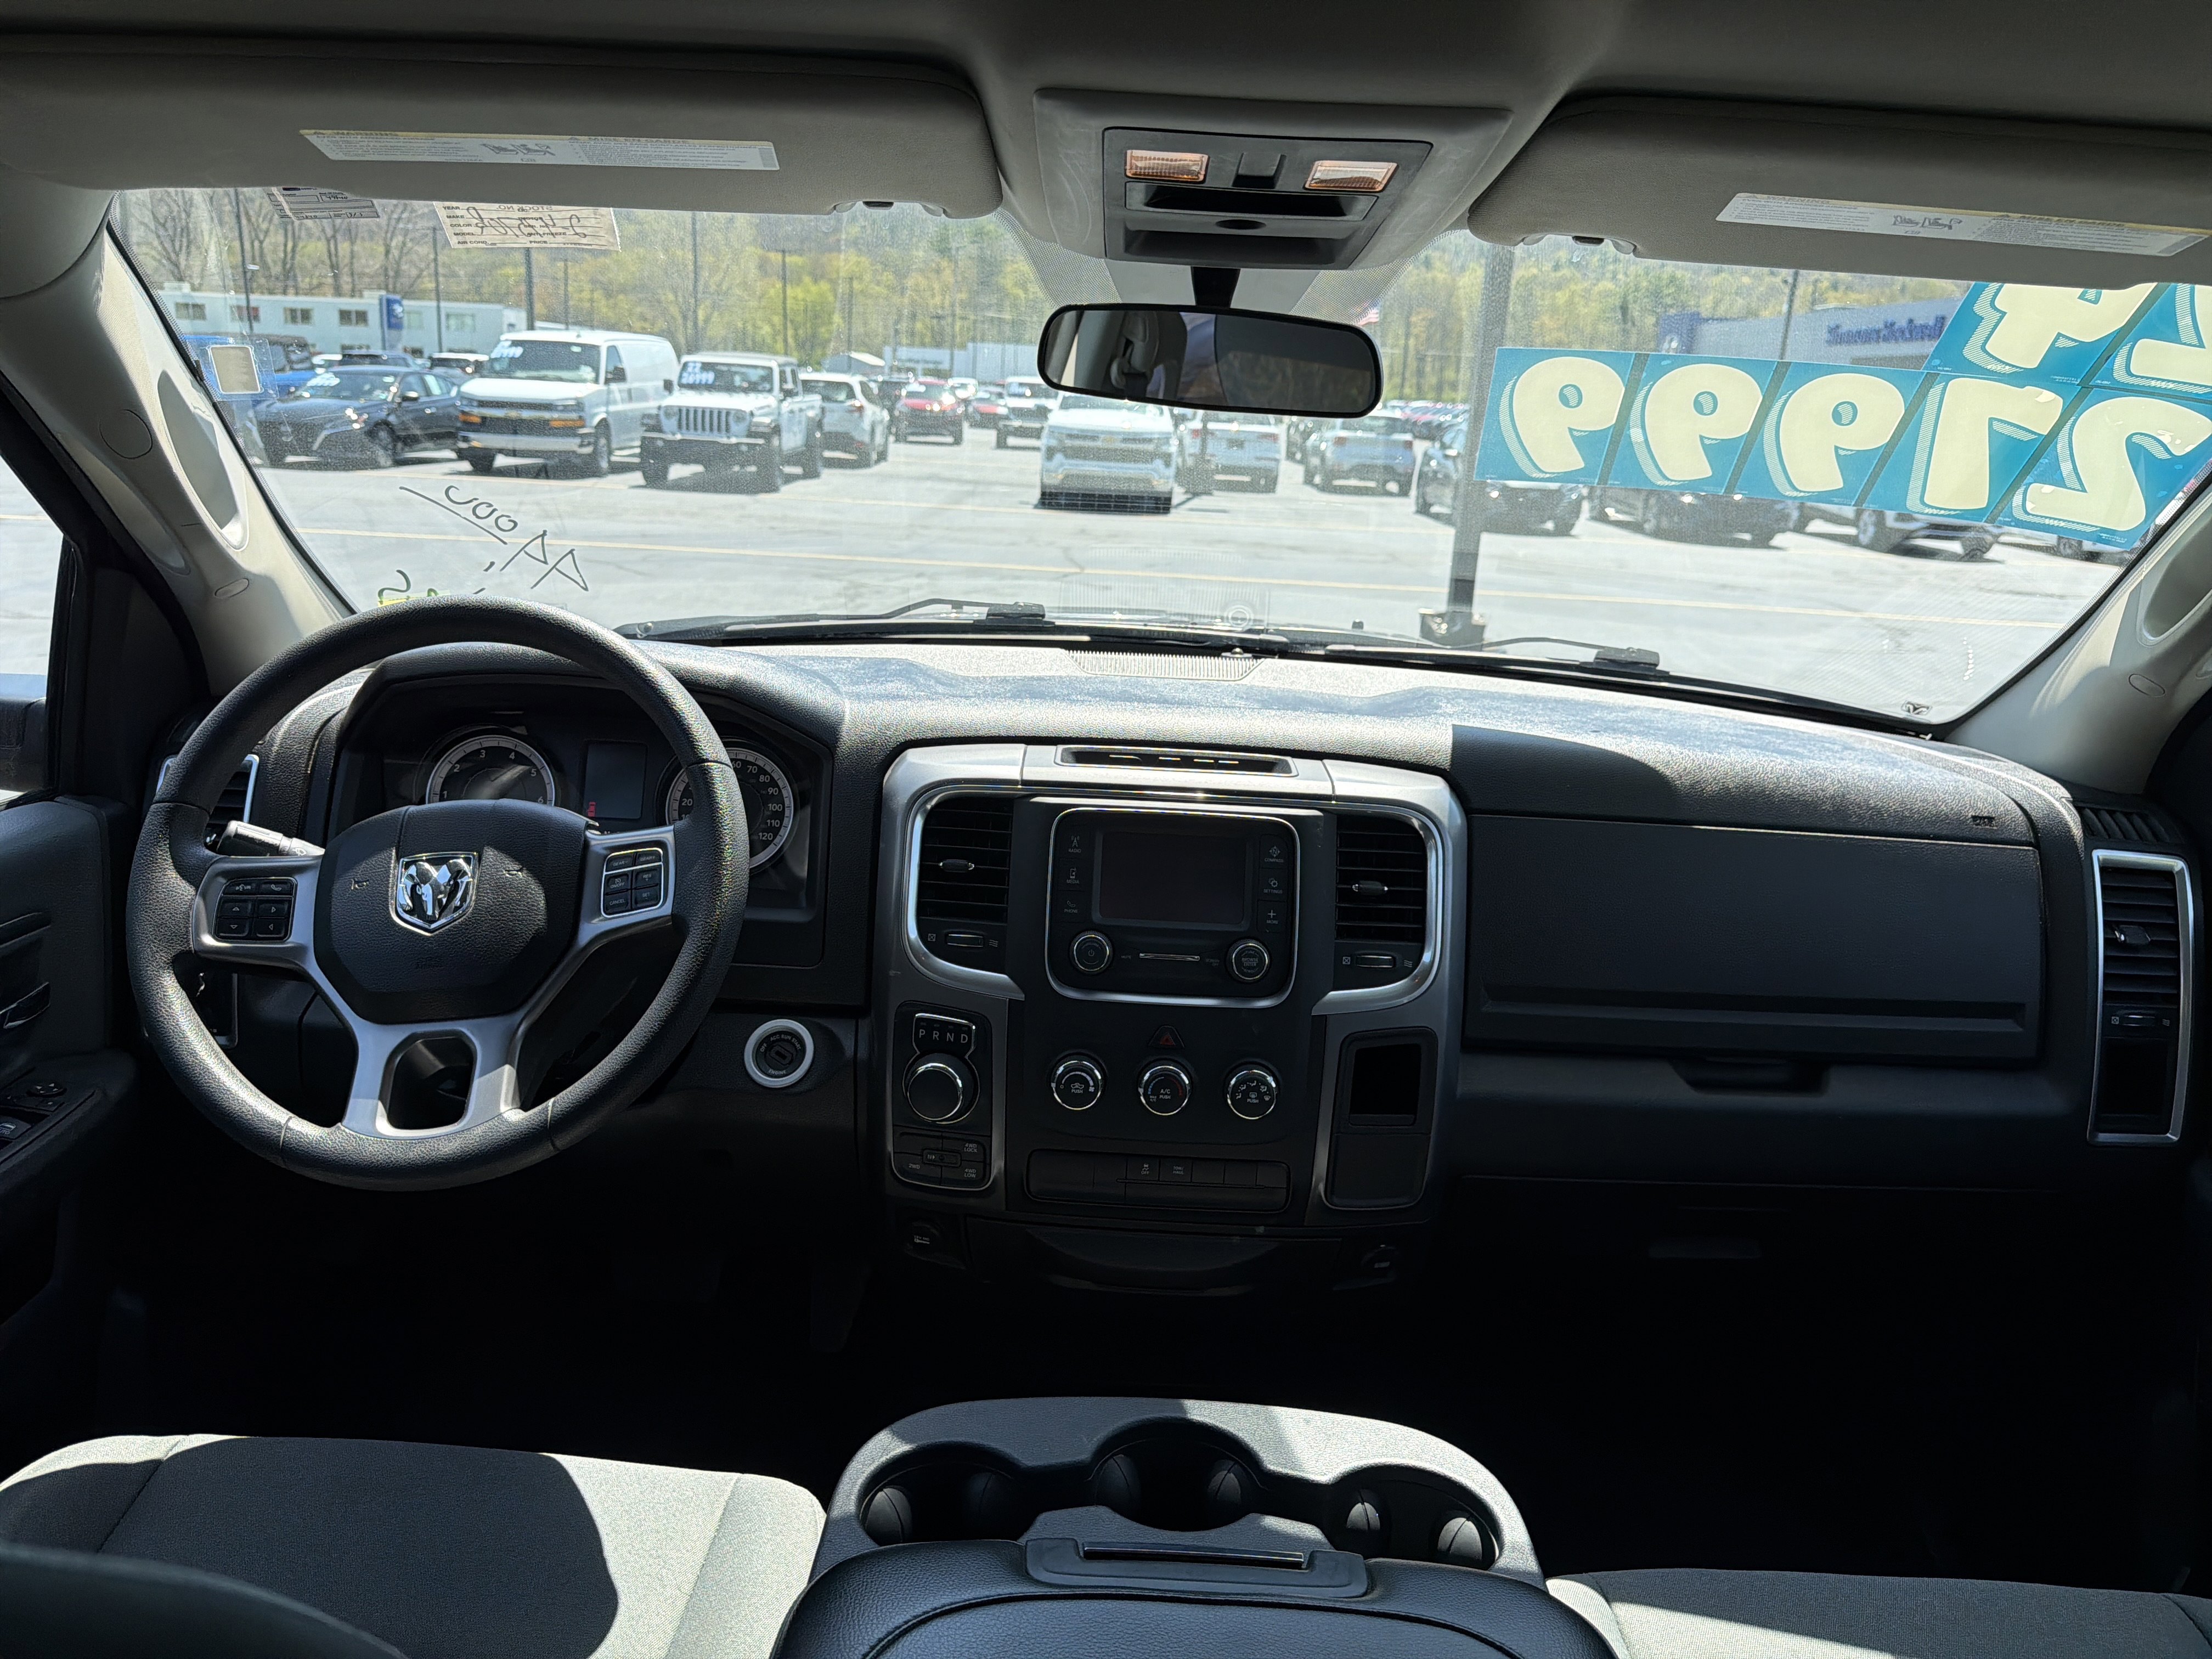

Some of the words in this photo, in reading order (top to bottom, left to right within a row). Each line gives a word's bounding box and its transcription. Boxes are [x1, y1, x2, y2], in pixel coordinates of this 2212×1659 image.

[479, 749, 486, 758] 3
[509, 751, 516, 760] 4
[453, 764, 461, 773] 2
[732, 760, 742, 769] 60
[531, 768, 537, 777] 5
[747, 765, 758, 774] 70
[759, 775, 770, 783] 80
[443, 791, 448, 799] 1
[768, 787, 778, 795] 90
[681, 798, 693, 806] 20
[768, 803, 783, 811] 100
[766, 819, 780, 827] 110
[759, 832, 774, 840] 120
[919, 1030, 926, 1039] P
[933, 1031, 940, 1041] R
[946, 1032, 955, 1042] N
[961, 1034, 968, 1043] D
[760, 1043, 768, 1052] OFF
[792, 1037, 802, 1050] START
